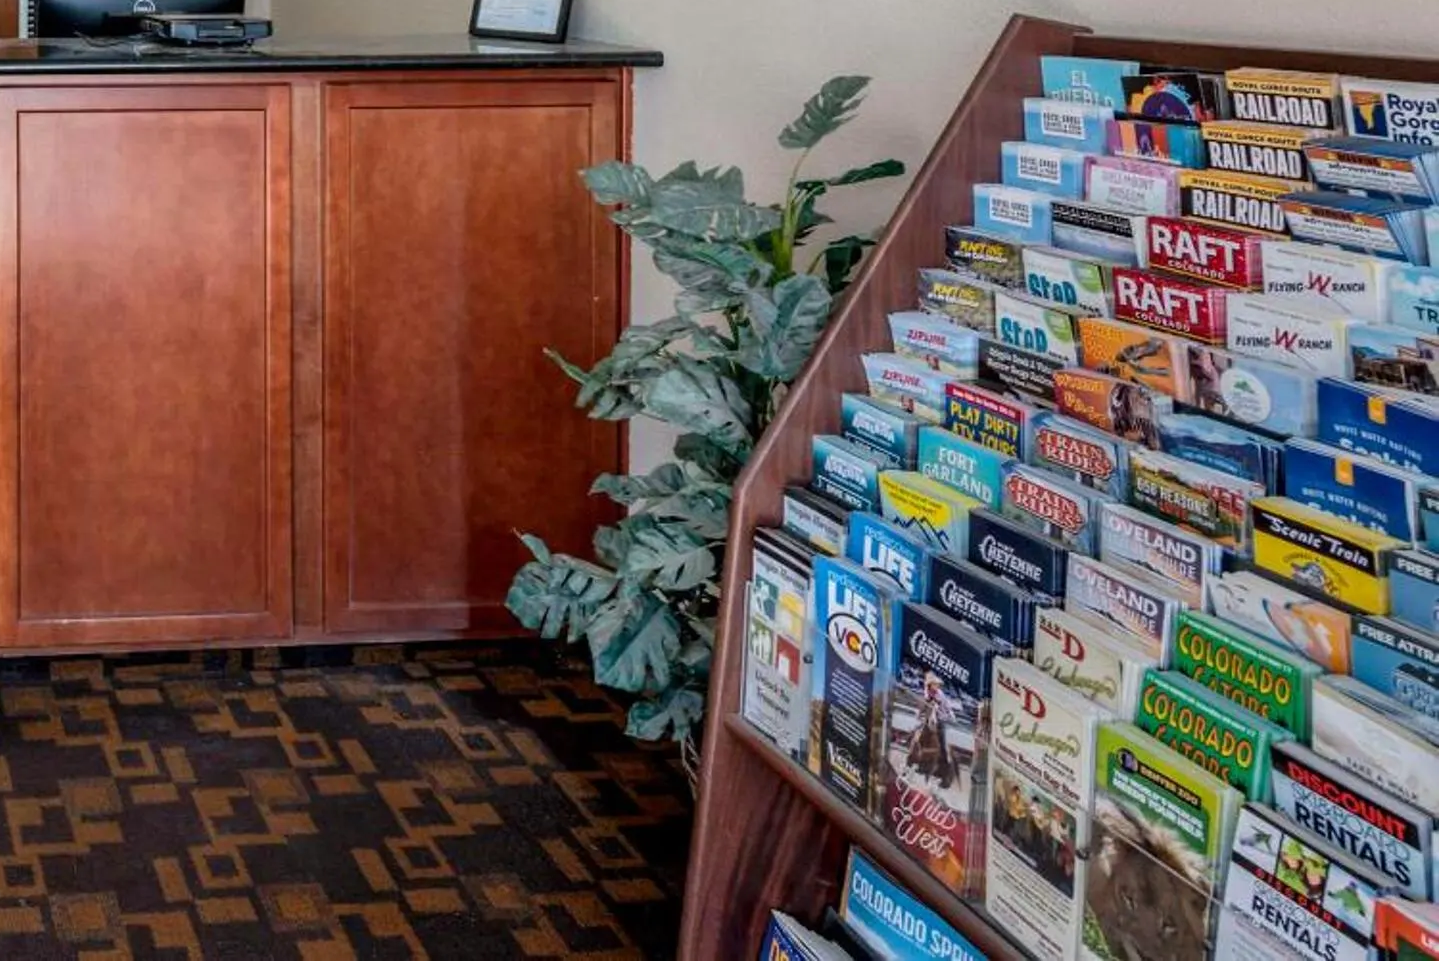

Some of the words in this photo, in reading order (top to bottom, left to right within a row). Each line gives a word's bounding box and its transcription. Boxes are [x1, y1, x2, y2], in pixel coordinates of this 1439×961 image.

[1071, 70, 1091, 87] EL
[1233, 91, 1328, 127] RAILROAD
[1387, 93, 1439, 116] Roya
[1210, 141, 1303, 179] RAILROAD
[1191, 189, 1285, 232] RAILROAD
[1151, 223, 1240, 273] RAFT
[1168, 258, 1226, 280] COLORADO
[1117, 276, 1205, 325] RAFT
[1267, 281, 1304, 293] FLYING
[1332, 283, 1366, 293] RANCH
[1135, 310, 1191, 332] COLORADO
[1235, 336, 1272, 347] FLYING
[1298, 339, 1333, 351] RANCH
[951, 400, 981, 426] PLAY
[984, 413, 1019, 445] DIRTY
[1045, 429, 1104, 460] TRAIN
[937, 446, 977, 472] FORT
[1045, 444, 1106, 476] RIDES
[922, 464, 994, 504] GARLAND
[1017, 478, 1076, 515] TRAIN
[1016, 491, 1077, 529] RIDES
[978, 534, 1043, 583] CHEYENNE
[1104, 510, 1198, 564] LOVELAND
[1262, 512, 1323, 549] Scenic
[1321, 535, 1370, 568] Train
[863, 535, 917, 595] LIFE
[1397, 557, 1434, 581] FREE
[827, 578, 878, 639] LIFE
[939, 579, 1002, 628] CHEYENNE
[1068, 560, 1159, 618] LOVELAND
[833, 621, 874, 665] VCO
[1060, 628, 1085, 663] D
[1357, 622, 1396, 647] FREE
[910, 630, 970, 684] CHEYENNE
[1179, 625, 1291, 705] COLORADO
[1023, 686, 1046, 720] D
[1143, 684, 1253, 768] COLORADO
[896, 776, 956, 830] Wild
[1287, 761, 1407, 842] DISCOUNT
[892, 807, 954, 858] West
[1294, 801, 1412, 887] RENTALS
[852, 871, 927, 944] COLORADO
[931, 928, 977, 961] SPR
[1251, 894, 1337, 961] RENTALS
